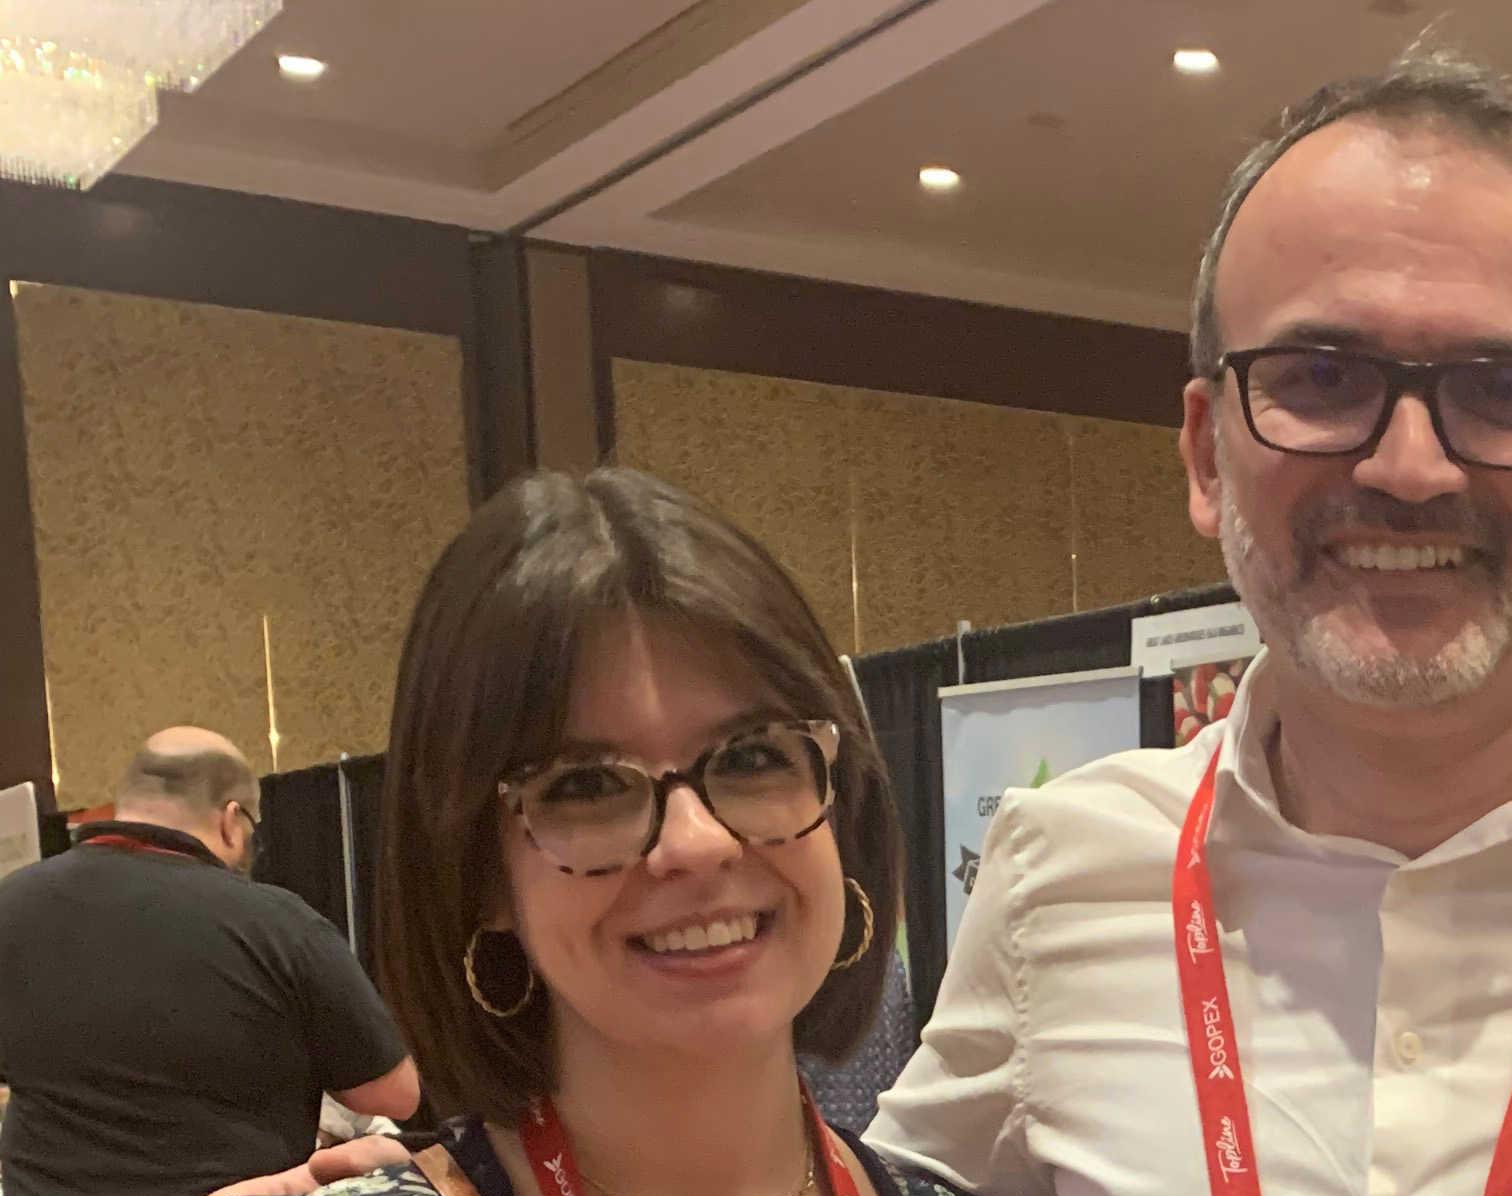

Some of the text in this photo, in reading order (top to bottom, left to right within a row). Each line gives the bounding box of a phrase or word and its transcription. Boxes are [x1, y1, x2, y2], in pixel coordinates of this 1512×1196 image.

[1187, 900, 1214, 964] Topline
[1202, 997, 1228, 1064] GOPEX
[1217, 1116, 1248, 1183] Topline
